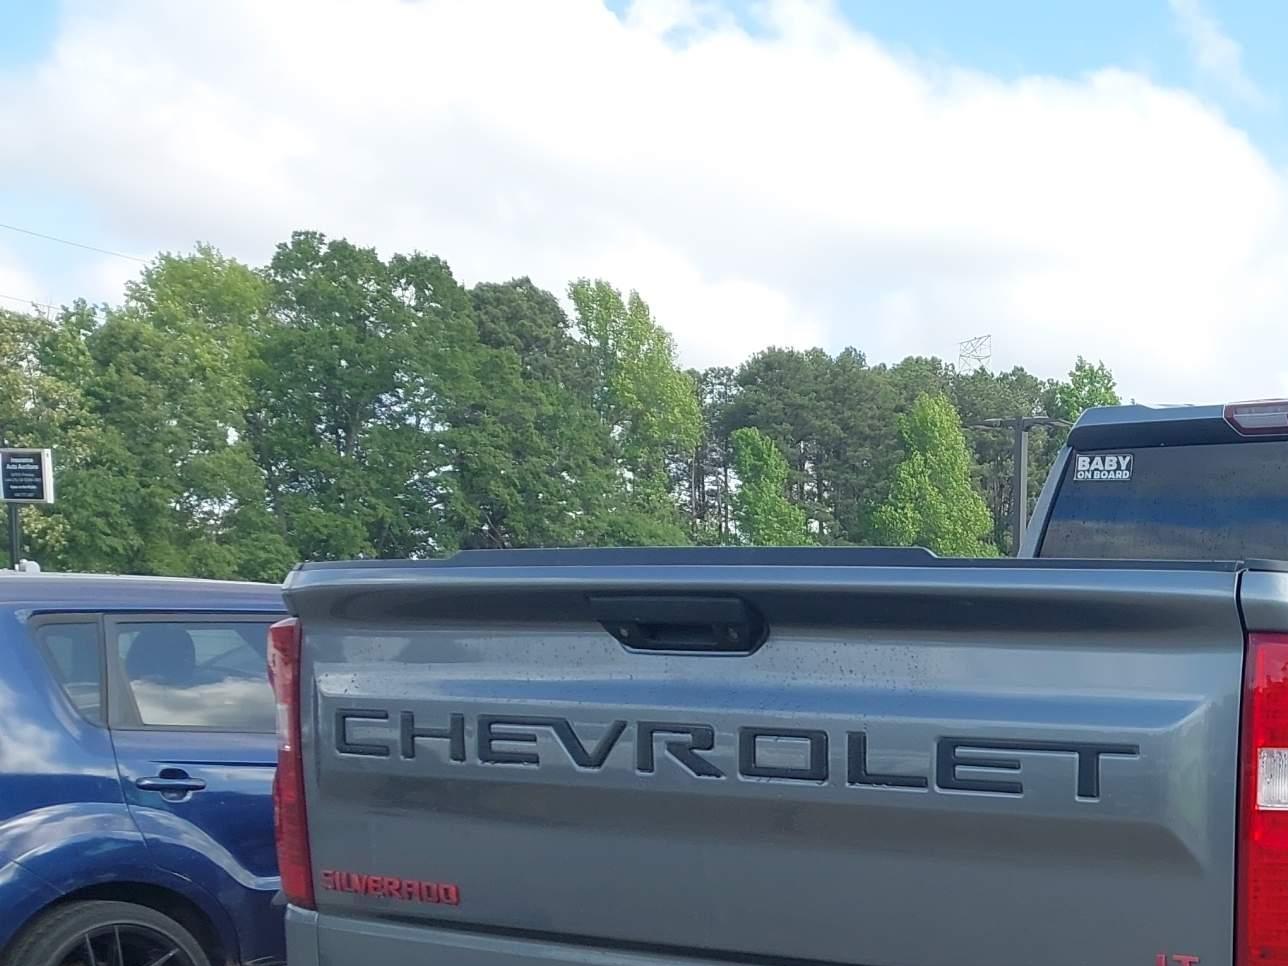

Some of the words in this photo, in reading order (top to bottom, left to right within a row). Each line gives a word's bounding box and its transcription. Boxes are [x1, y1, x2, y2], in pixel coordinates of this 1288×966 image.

[1077, 471, 1091, 479] ON
[1093, 470, 1130, 479] BOARD
[1078, 456, 1130, 471] BABY
[334, 708, 1141, 802] CHEVROLET
[320, 869, 460, 907] SILVERADO
